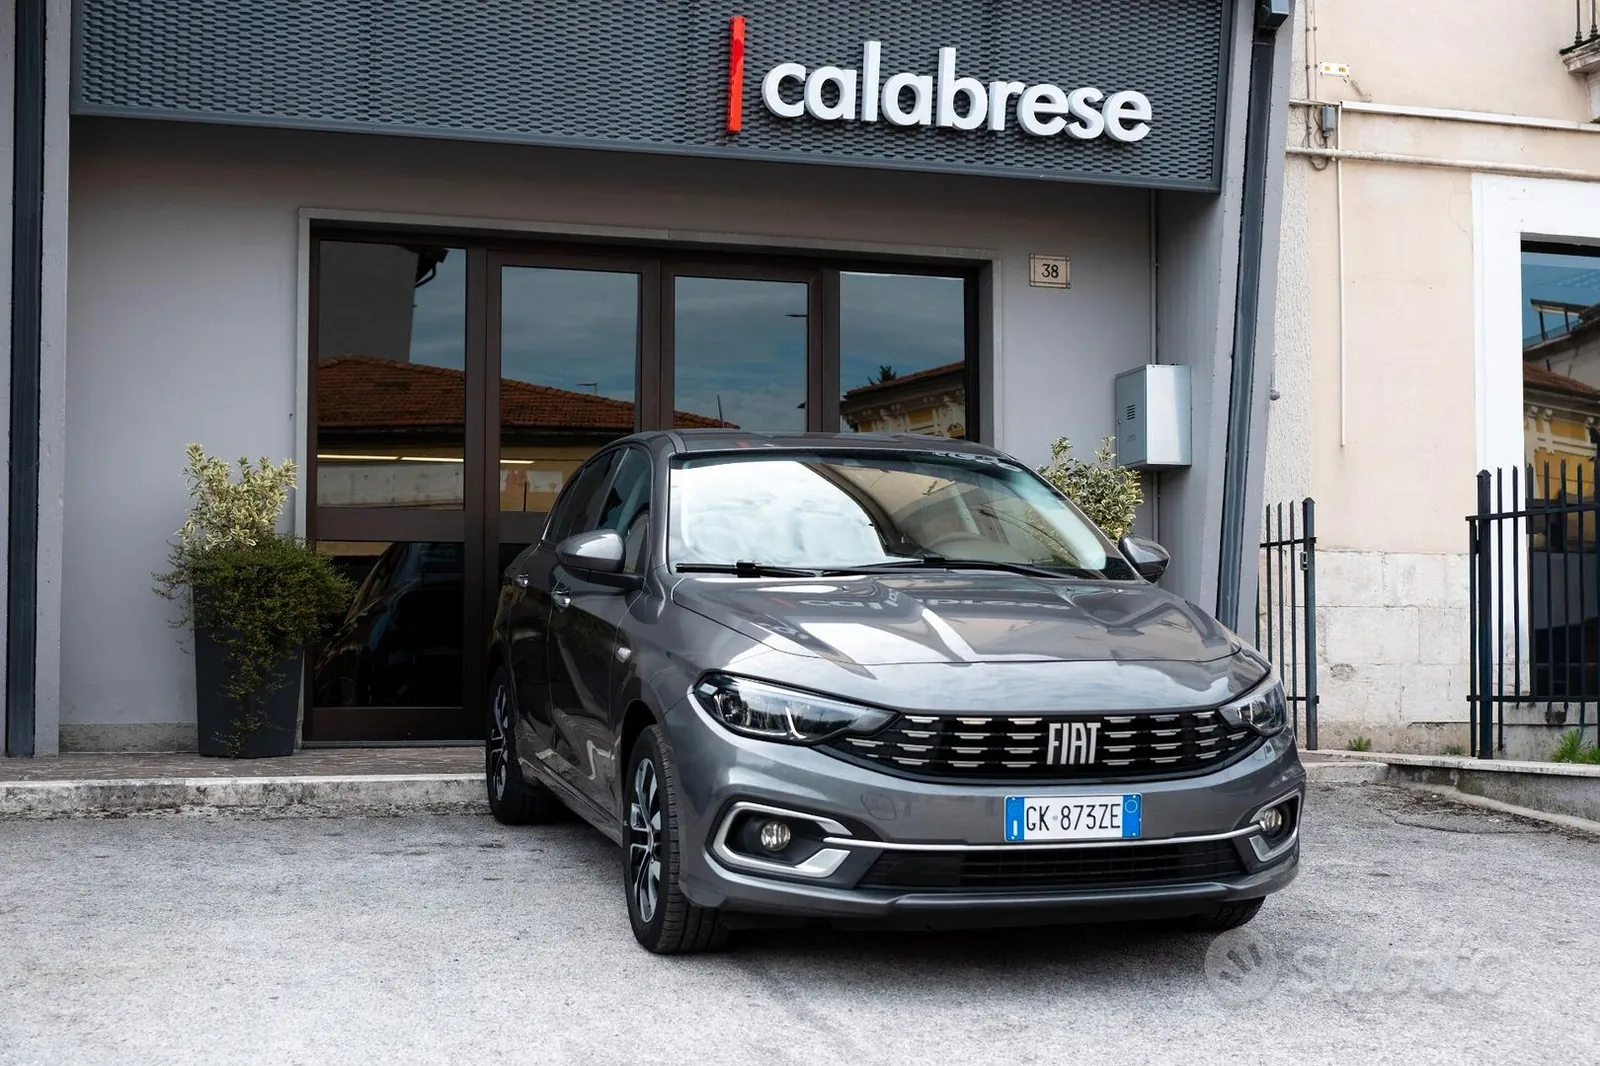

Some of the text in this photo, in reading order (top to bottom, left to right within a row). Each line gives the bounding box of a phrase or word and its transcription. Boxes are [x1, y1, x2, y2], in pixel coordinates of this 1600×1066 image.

[761, 41, 1153, 142] calabrese
[1041, 263, 1059, 279] 38
[1047, 723, 1101, 764] FIAT
[1026, 804, 1121, 831] GK 873ZE
